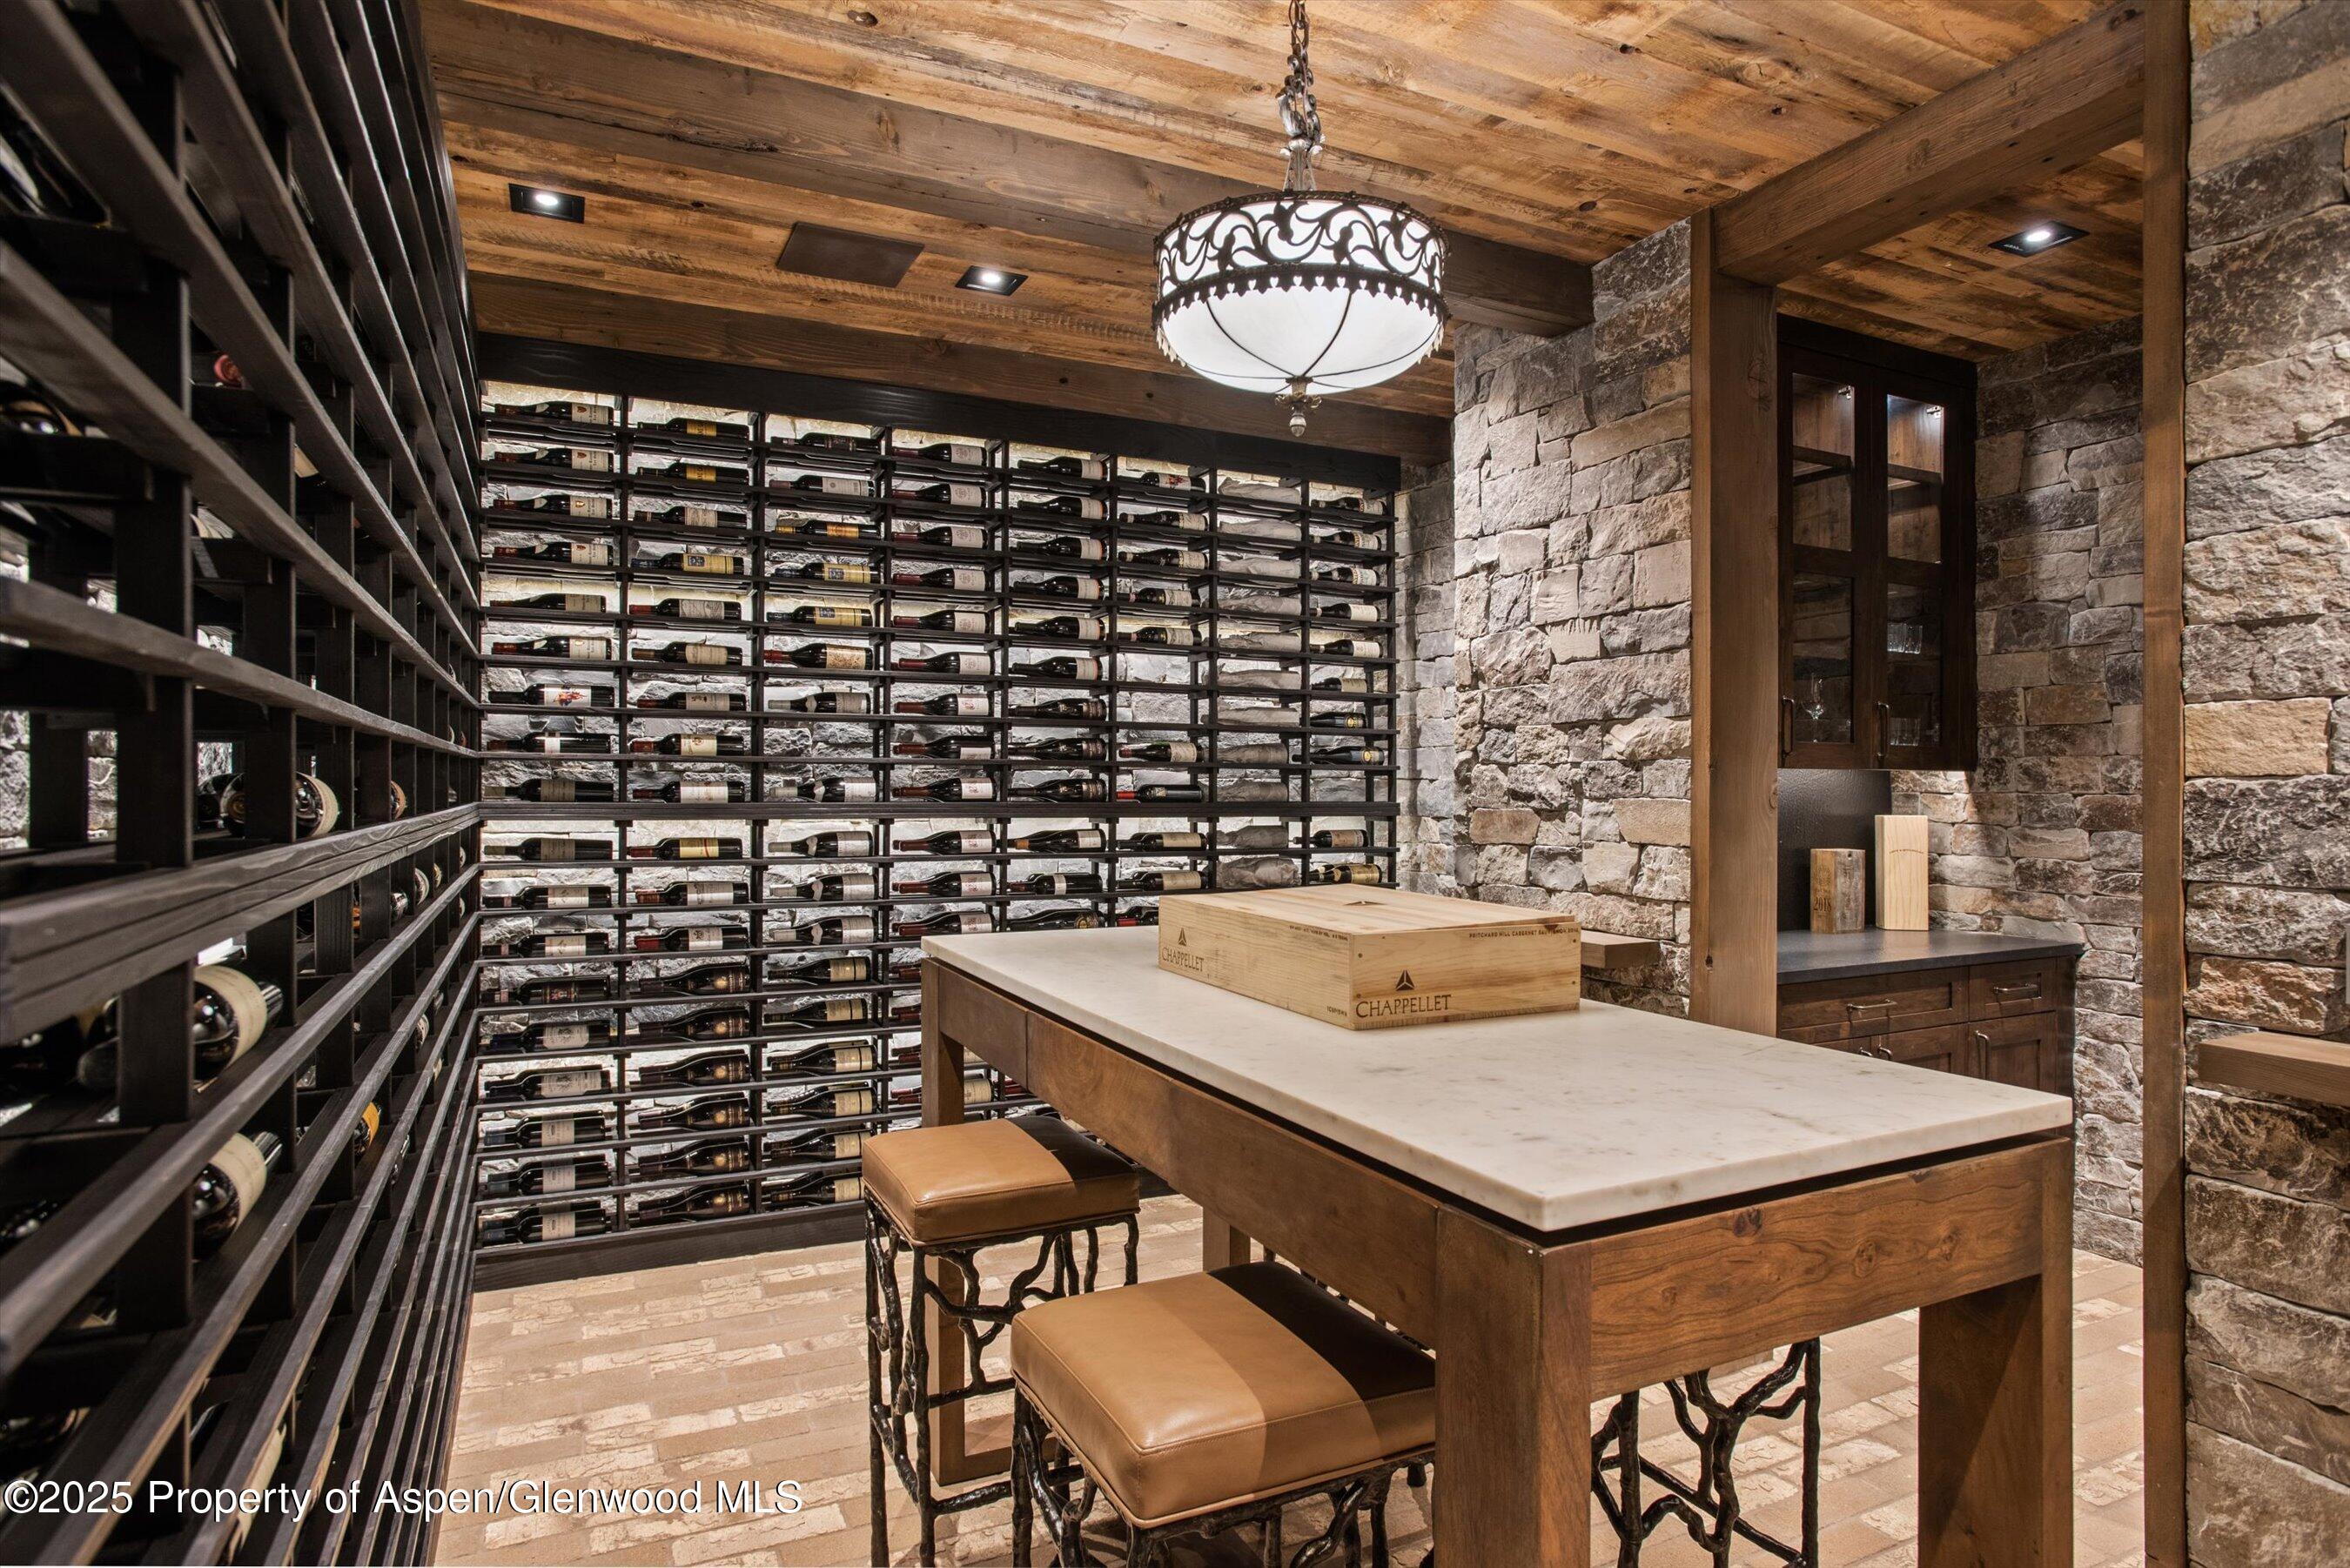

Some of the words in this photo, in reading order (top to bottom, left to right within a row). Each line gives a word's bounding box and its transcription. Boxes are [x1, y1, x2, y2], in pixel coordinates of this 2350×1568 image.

[1813, 896, 1831, 912] 2018
[1162, 947, 1205, 972] CHAPPELLET
[1355, 994, 1452, 1018] CHAPPELLET
